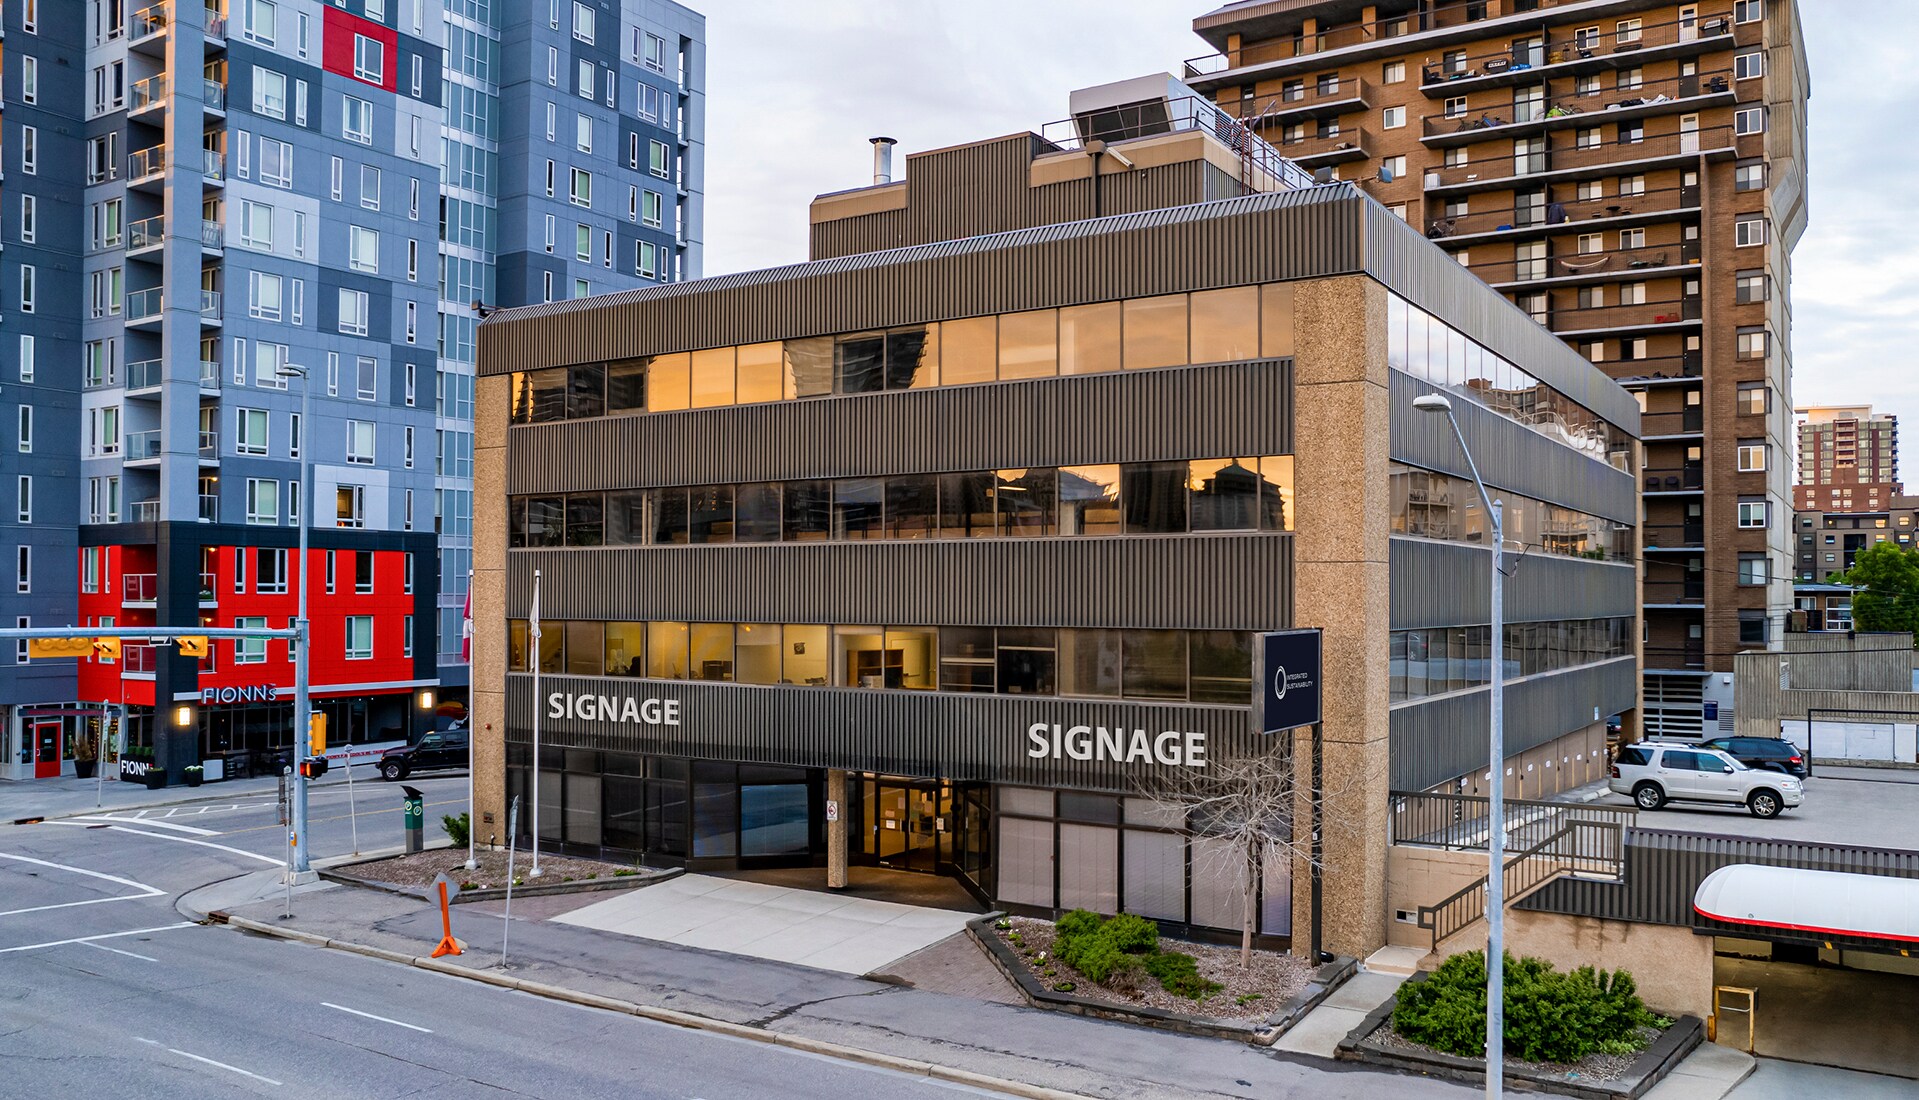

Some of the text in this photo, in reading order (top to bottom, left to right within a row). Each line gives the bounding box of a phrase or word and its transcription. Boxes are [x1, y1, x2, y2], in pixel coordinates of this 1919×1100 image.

[1287, 672, 1308, 680] INTEGRATED
[1287, 681, 1313, 690] SUSTAINABILITY
[549, 692, 679, 725] SIGNAGE
[1028, 722, 1206, 767] SIGNAGE
